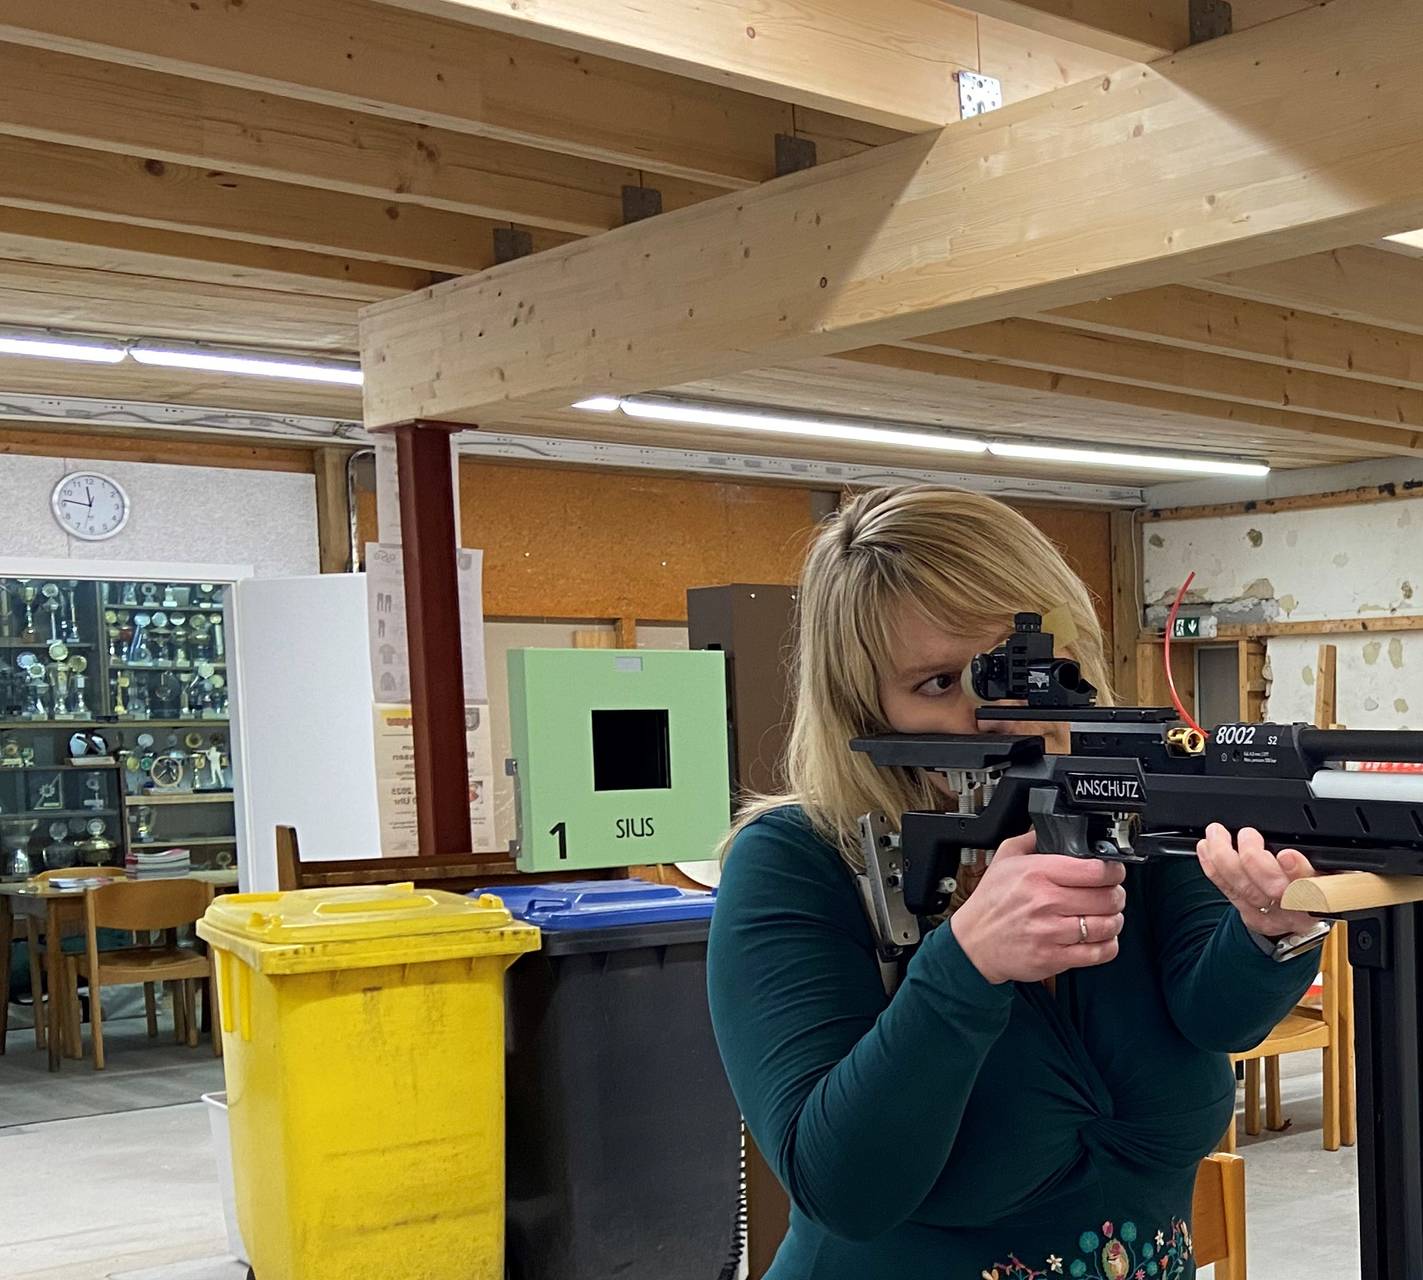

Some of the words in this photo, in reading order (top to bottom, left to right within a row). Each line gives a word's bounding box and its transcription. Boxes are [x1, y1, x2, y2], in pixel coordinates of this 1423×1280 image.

[1216, 726, 1256, 744] 8002
[1267, 736, 1278, 745] S2
[1075, 779, 1139, 798] ANSCHÜTZ
[616, 817, 655, 839] SIUS
[549, 822, 567, 859] 1
